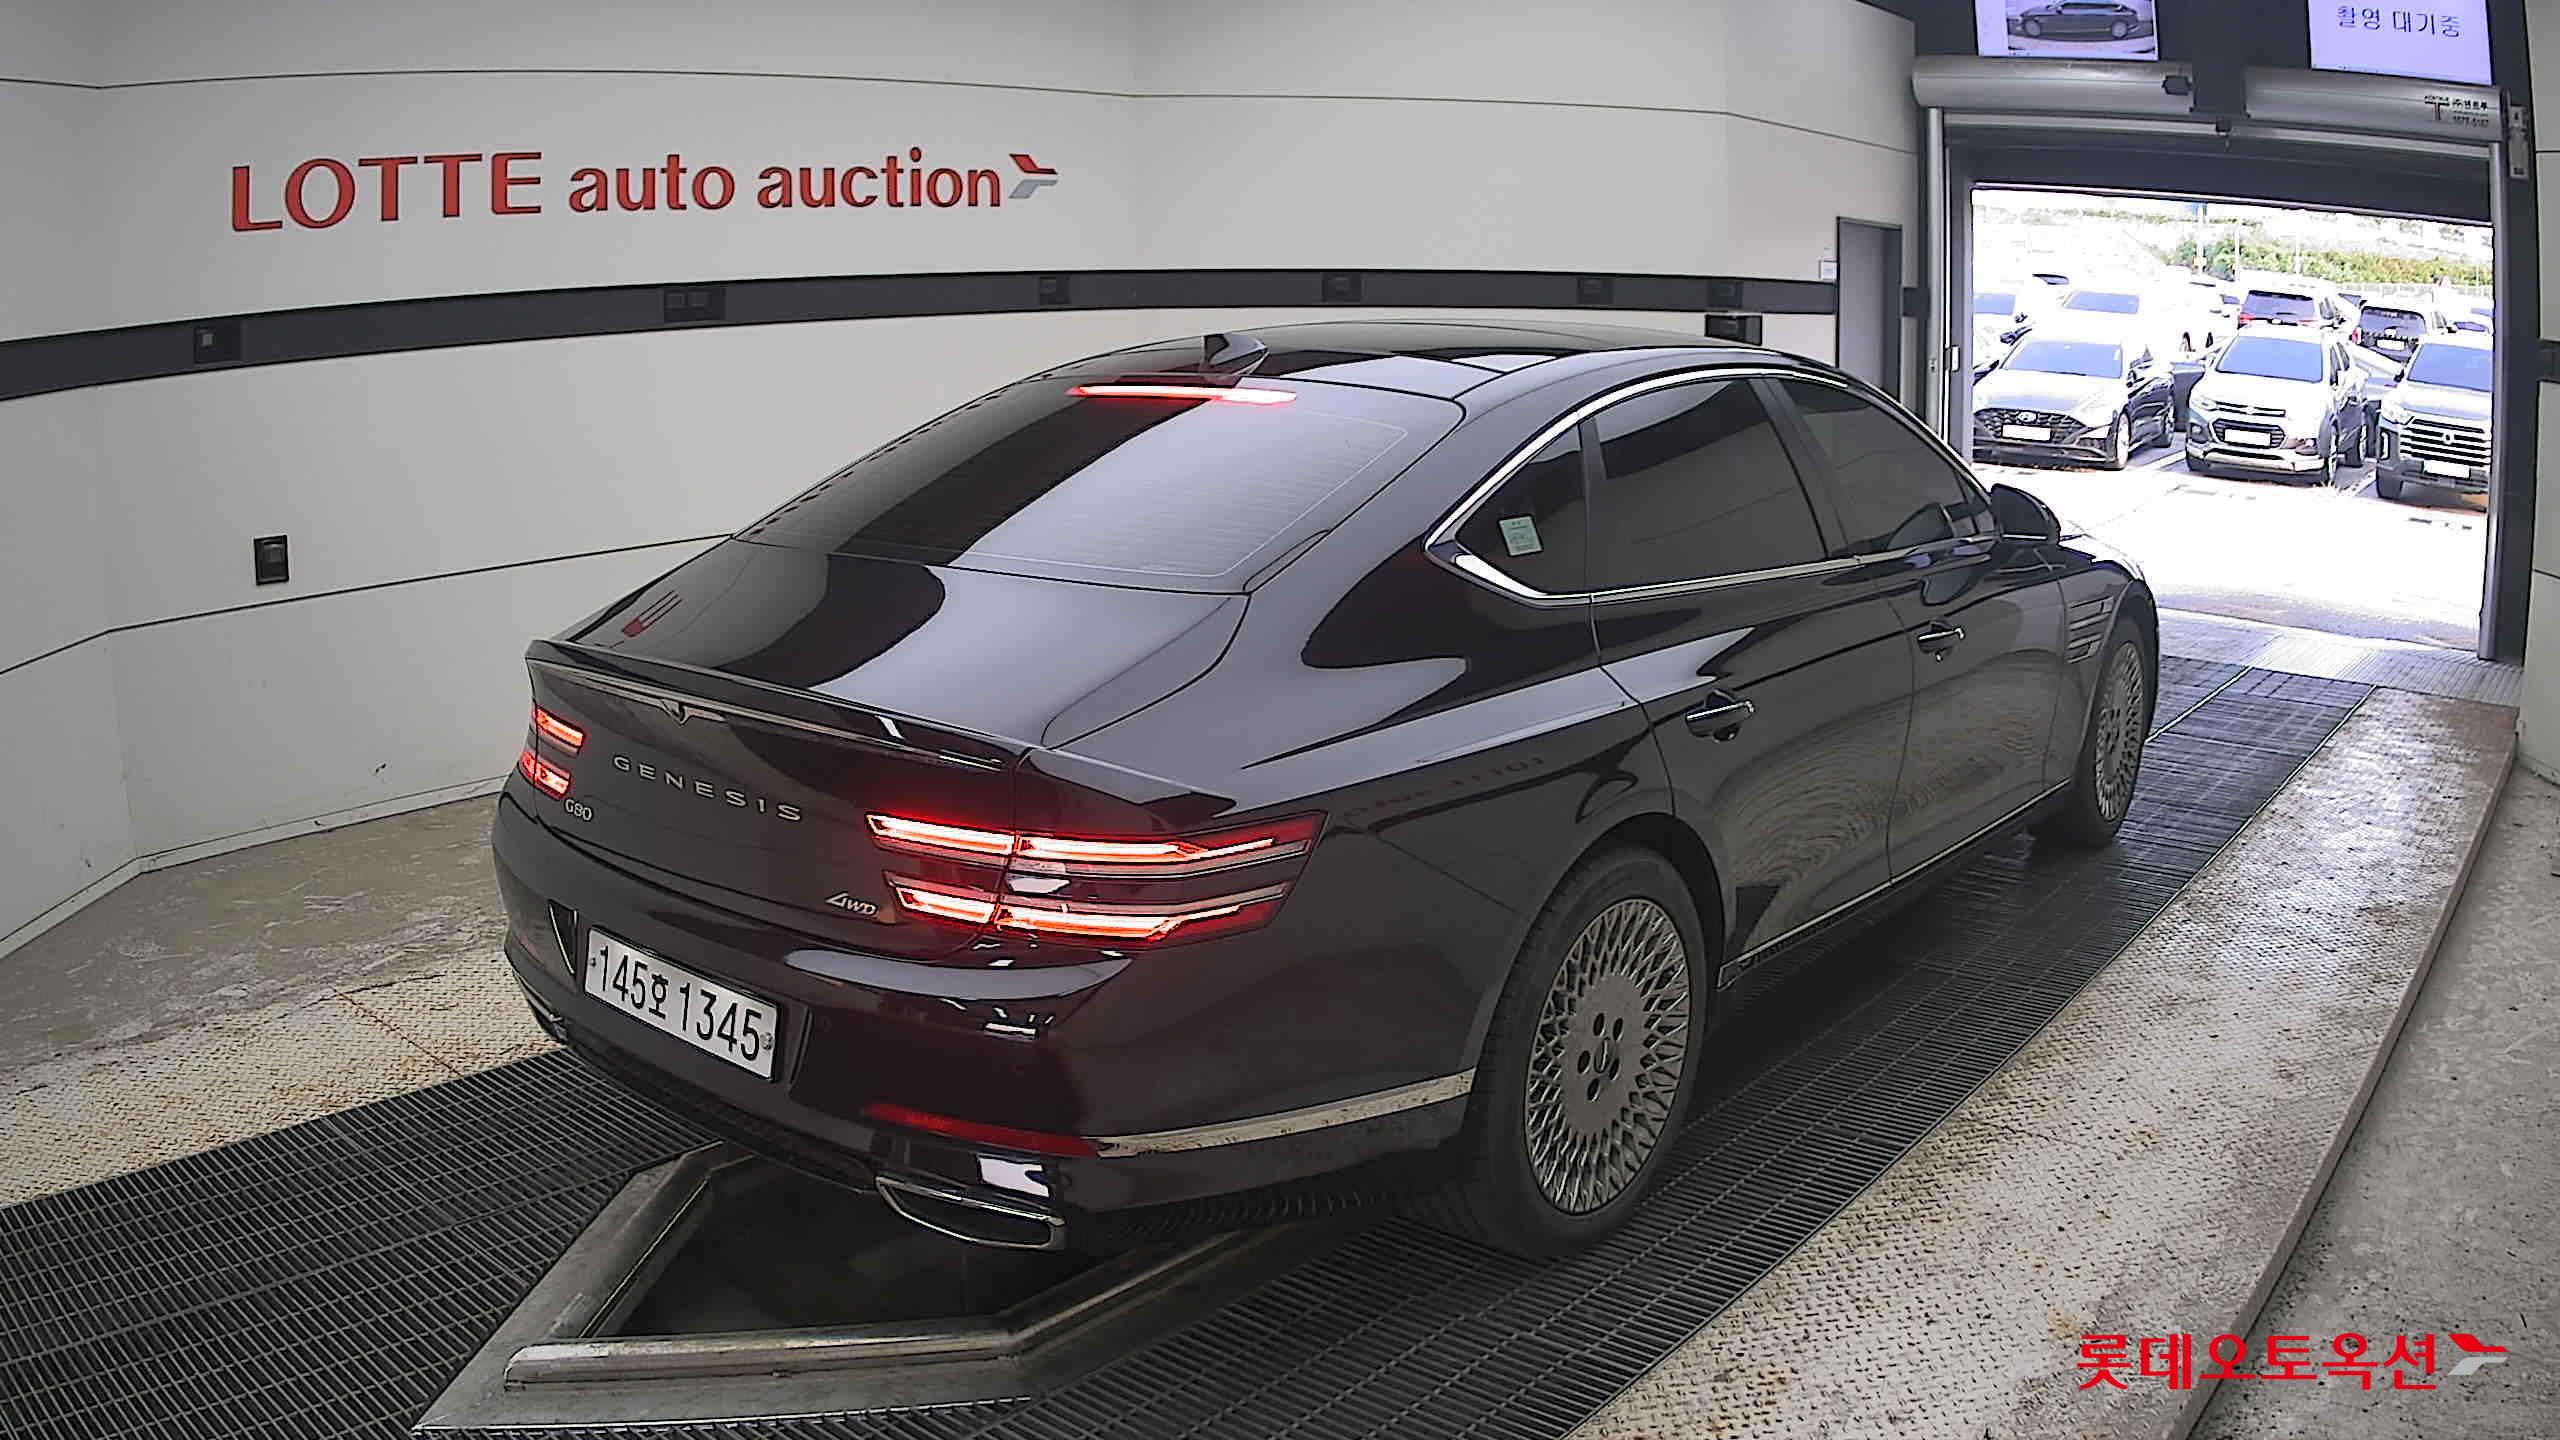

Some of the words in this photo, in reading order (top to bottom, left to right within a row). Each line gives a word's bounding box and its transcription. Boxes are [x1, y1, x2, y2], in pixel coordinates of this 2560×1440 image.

[2337, 5, 2381, 31] 촬영
[2392, 10, 2461, 38] 대기중
[232, 151, 541, 232] LOTTE
[568, 153, 736, 212] auto
[757, 148, 1002, 208] auction
[565, 799, 592, 821] G80
[613, 755, 801, 822] GENESIS
[600, 945, 669, 1020] 145호
[679, 981, 764, 1062] 1345
